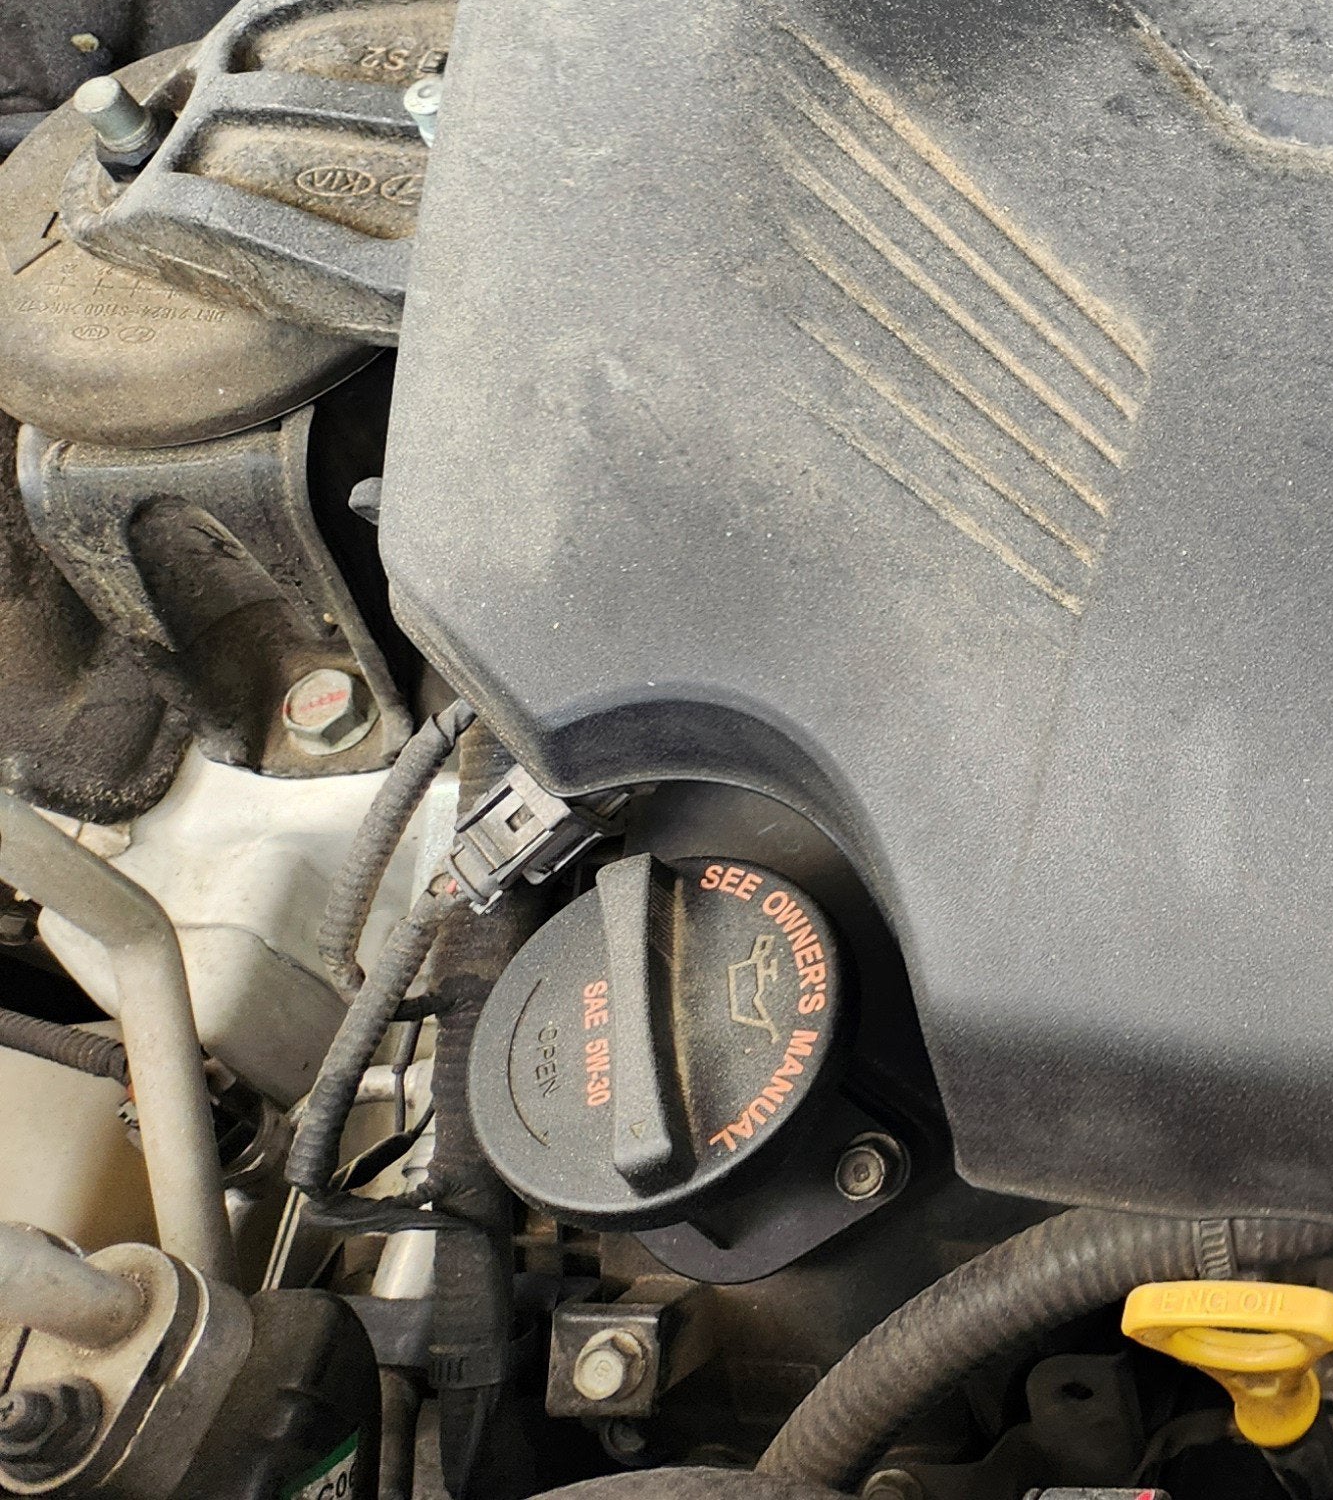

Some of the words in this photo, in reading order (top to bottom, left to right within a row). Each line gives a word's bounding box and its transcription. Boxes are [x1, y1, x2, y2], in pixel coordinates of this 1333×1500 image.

[312, 168, 364, 193] KIA
[700, 864, 764, 901] SEE
[762, 890, 827, 1015] OWNER'S
[583, 980, 608, 1030] SAE
[535, 1026, 562, 1098] OPEN
[585, 1038, 611, 1107] 5W-30
[709, 1029, 819, 1153] MANUAL
[1160, 1289, 1229, 1313] ENG
[1240, 1289, 1285, 1317] OIL
